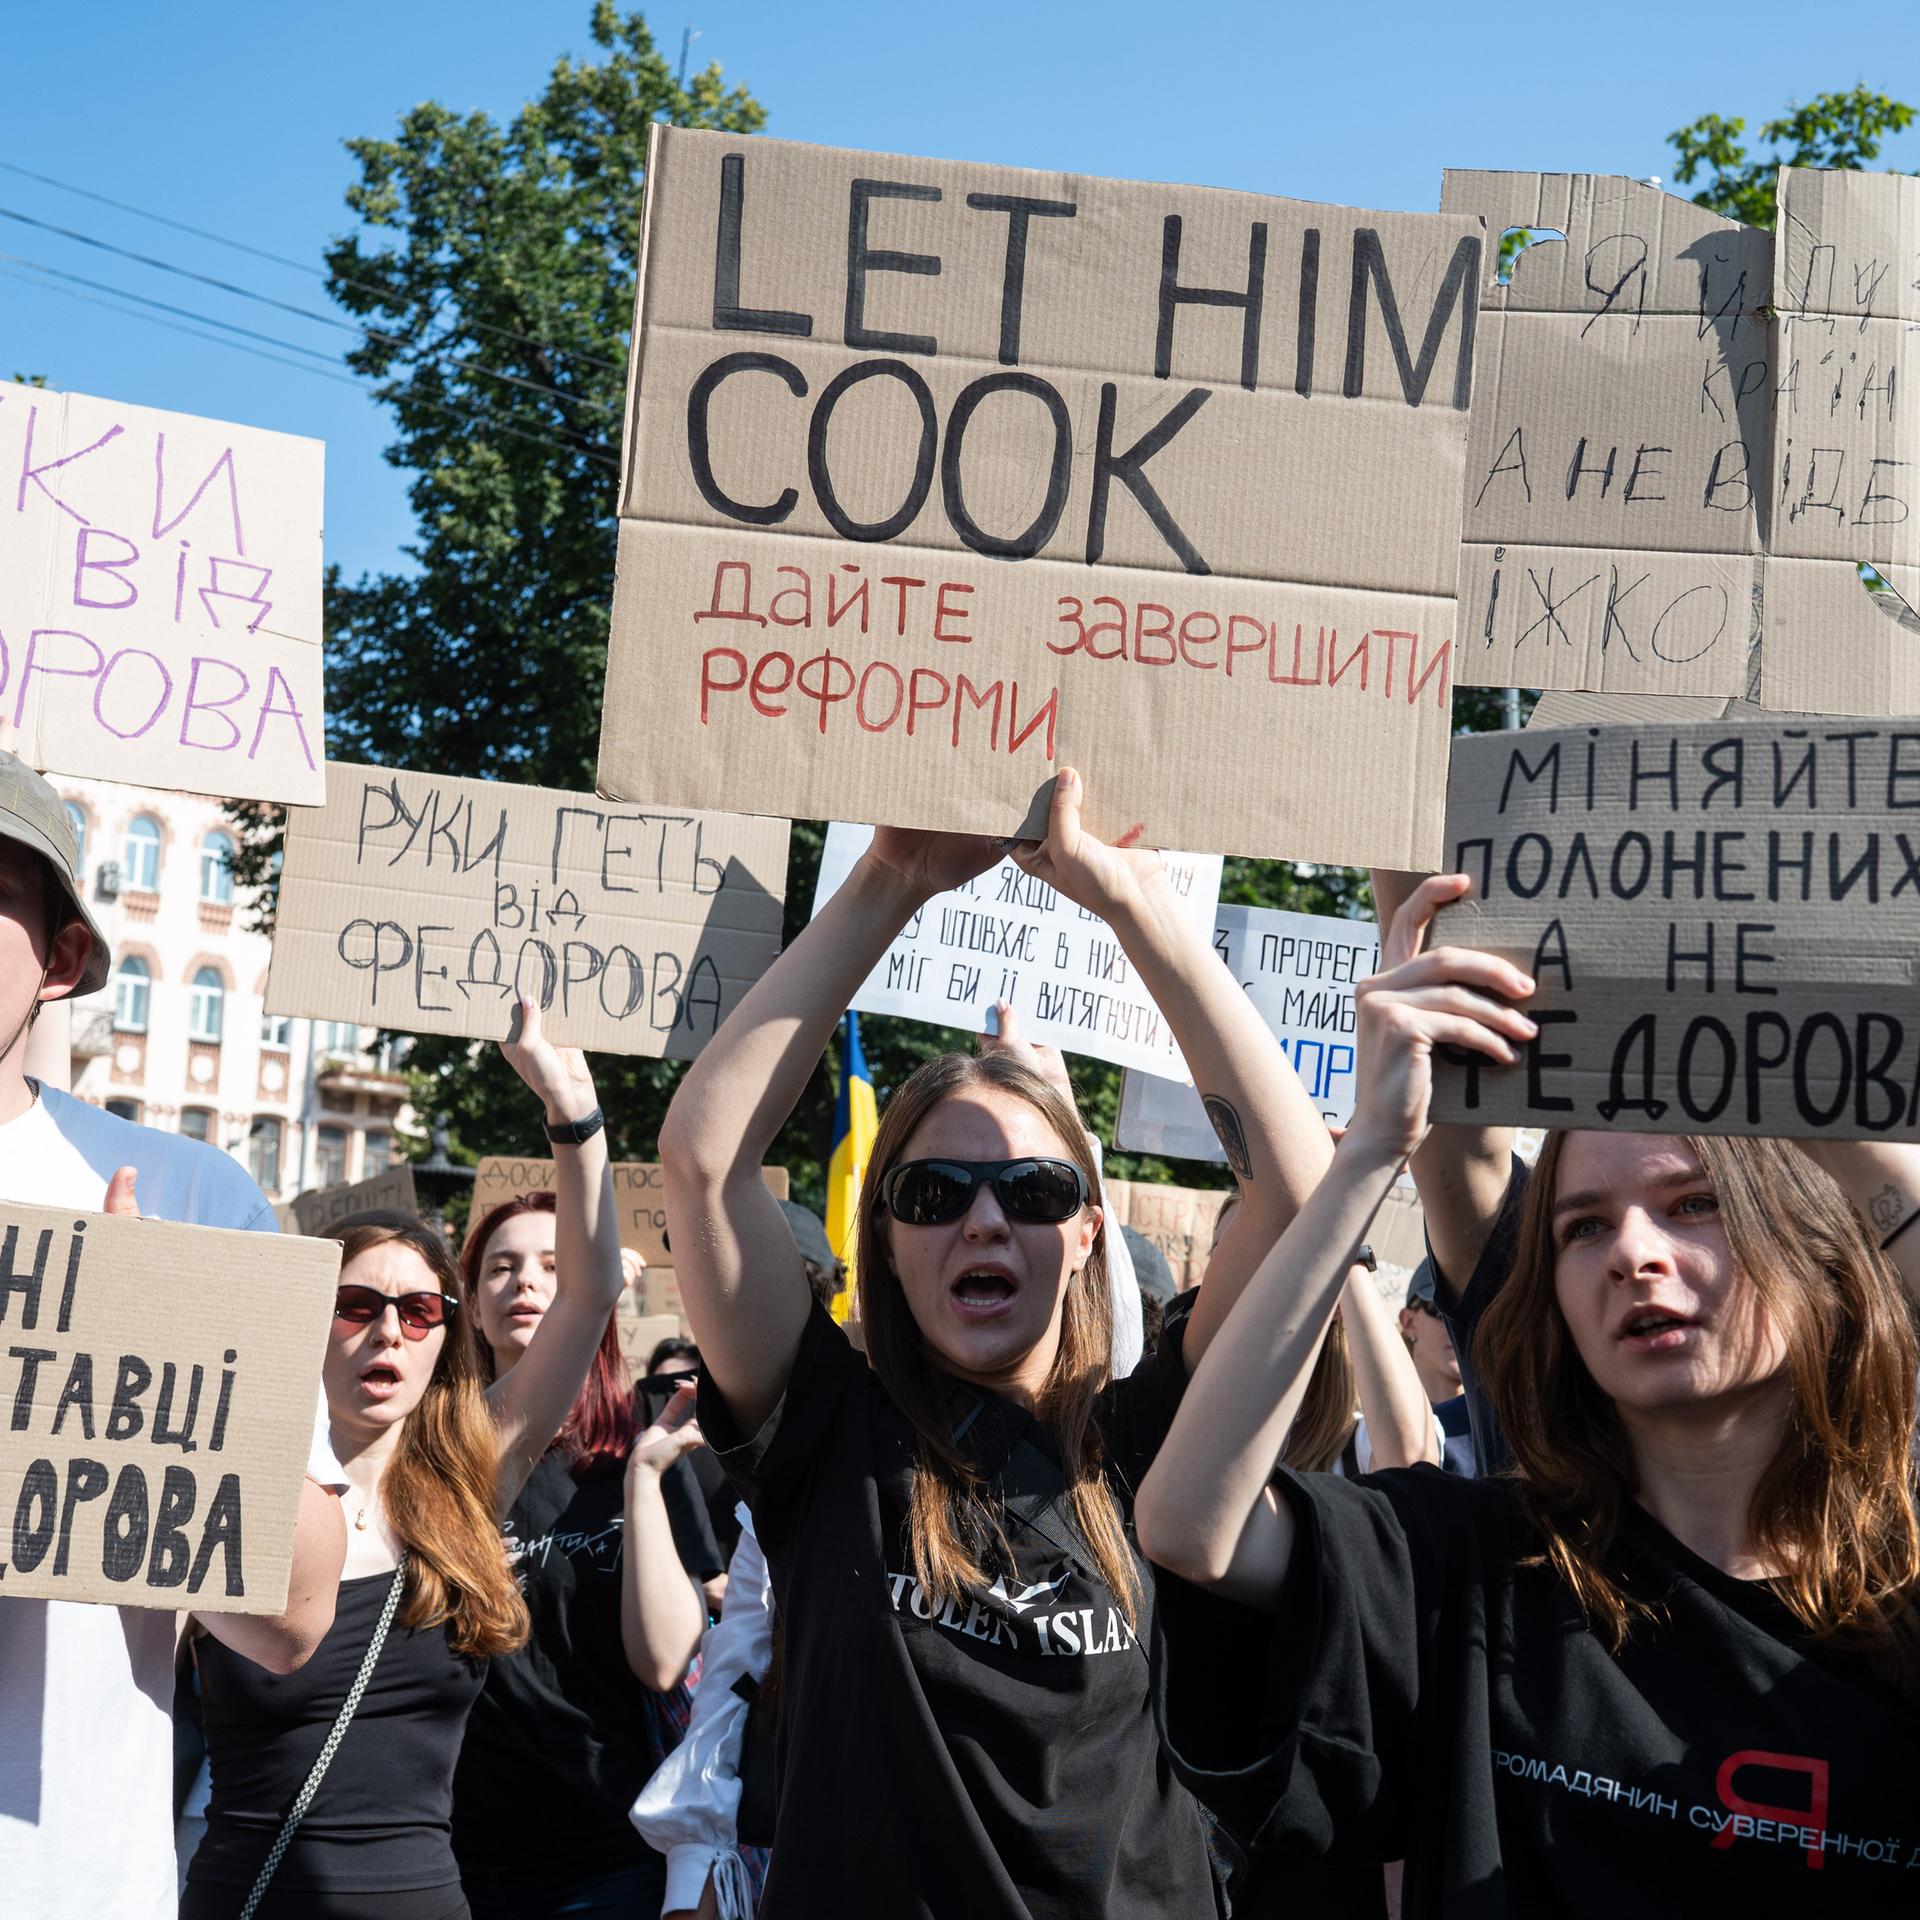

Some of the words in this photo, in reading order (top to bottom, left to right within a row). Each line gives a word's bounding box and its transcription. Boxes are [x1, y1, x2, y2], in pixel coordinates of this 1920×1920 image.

[713, 153, 1075, 366] LET
[1155, 213, 1481, 412] HIM
[1581, 234, 1648, 338] Я
[687, 352, 1213, 576] COOK
[1474, 427, 1531, 508] А
[1565, 436, 1673, 505] НЕ
[356, 777, 507, 879] РУКИ
[552, 807, 727, 896] ГЕТЬ
[338, 918, 723, 1036] ФЕДОРОВА
[886, 948, 933, 994] МІГ
[946, 963, 981, 1005] БИ
[999, 967, 1019, 1005] ЇЇ
[940, 907, 1040, 962] ШТОВХАЄ
[1055, 931, 1069, 970] В
[1532, 918, 1574, 992] А
[1666, 921, 1779, 995] НЕ
[1281, 984, 1357, 1034] МАЙБ
[1437, 1009, 1920, 1131] ЕДОРОВ
[0, 1220, 87, 1333] НІ
[0, 1458, 245, 1598] ОРОВА
[1491, 1749, 1678, 1820] РОМАДЯНИН
[1688, 1805, 1901, 1864] СУВЕРЕННОЇ
[1710, 1749, 1830, 1870] Я
